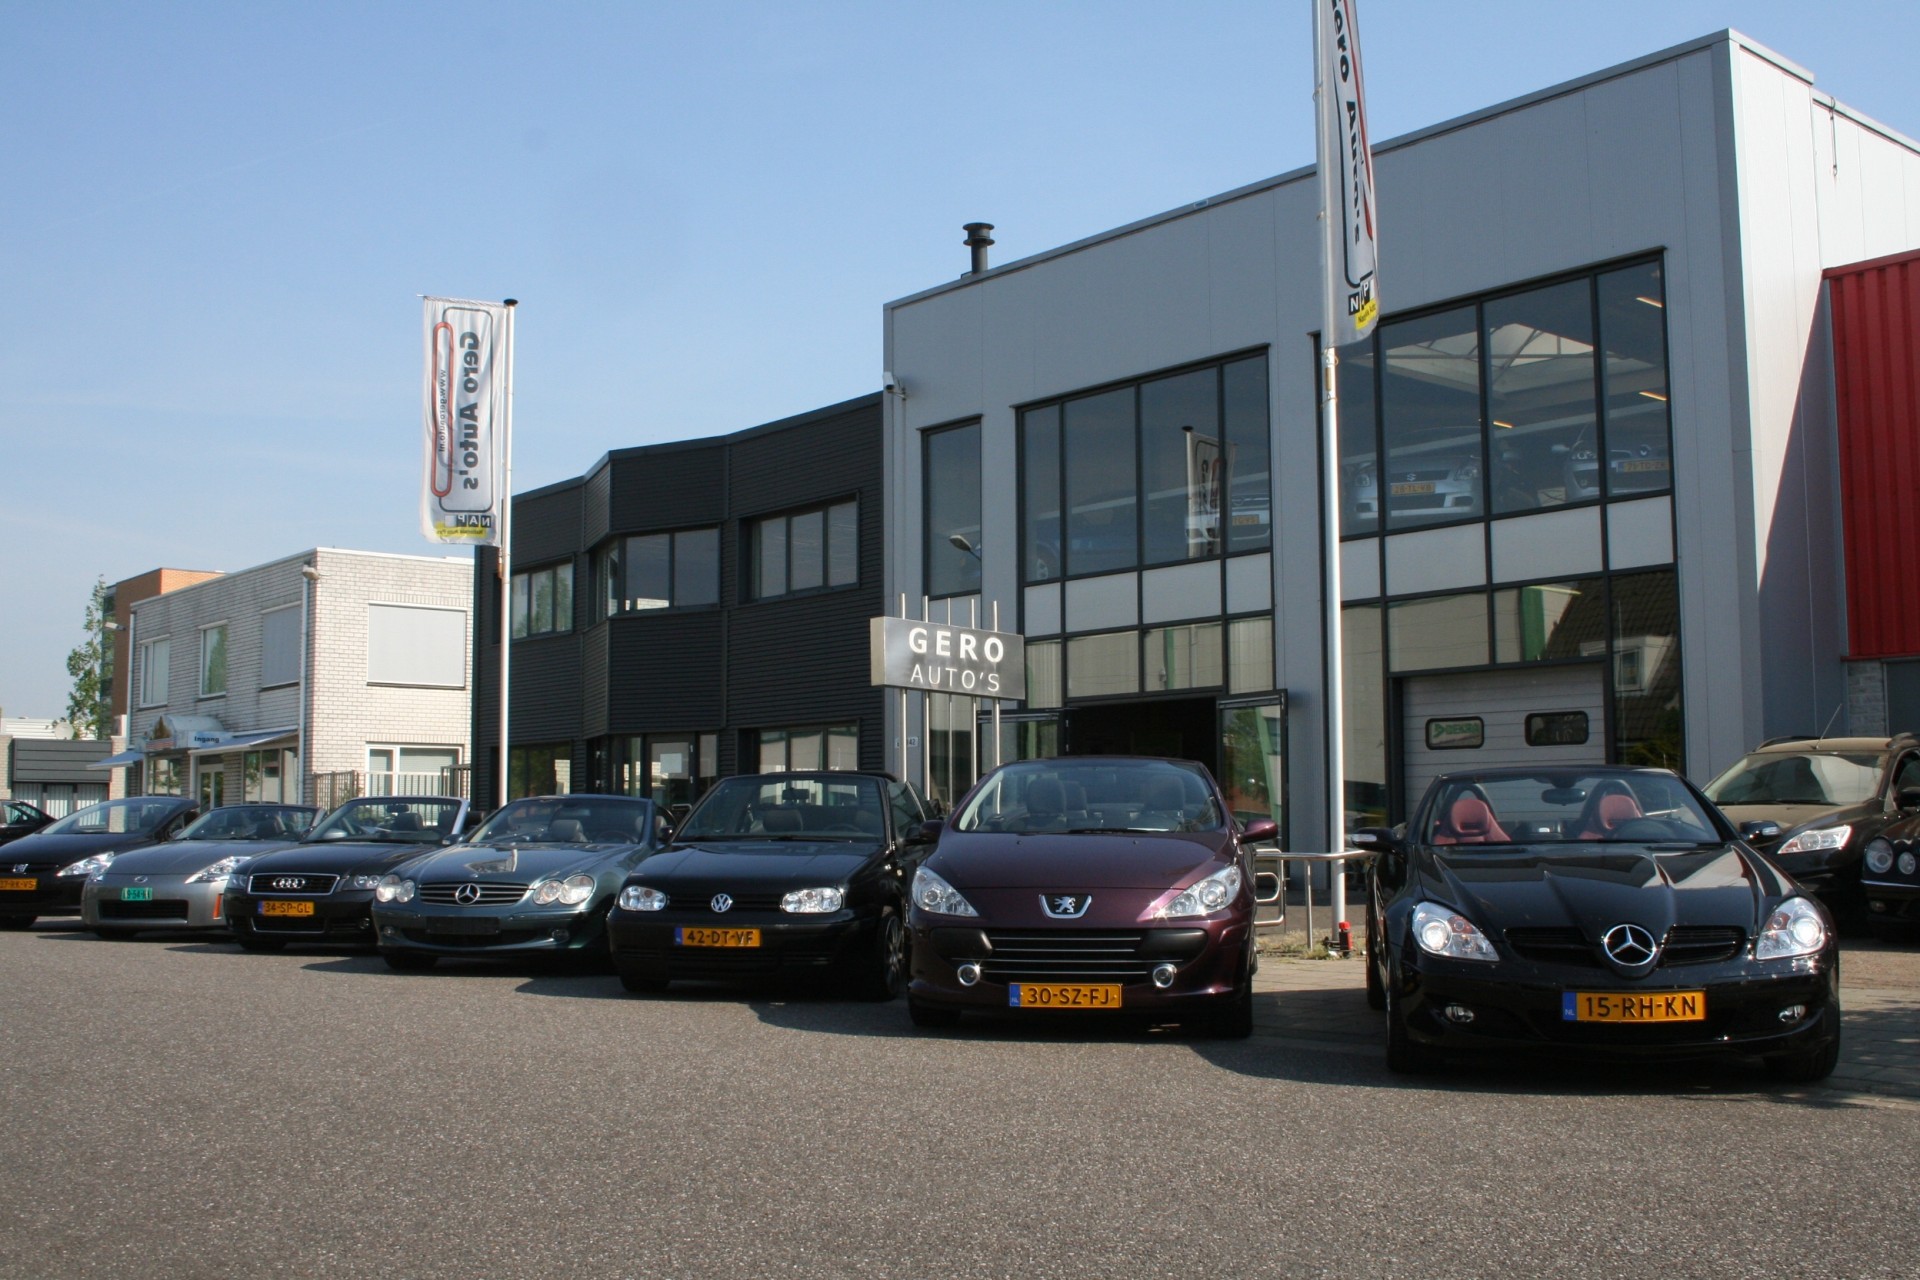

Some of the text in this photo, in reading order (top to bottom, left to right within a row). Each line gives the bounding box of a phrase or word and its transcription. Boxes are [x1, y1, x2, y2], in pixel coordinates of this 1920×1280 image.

[1350, 281, 1369, 312] NP
[908, 627, 1004, 663] GERO
[910, 664, 1000, 692] AUTO'S
[194, 735, 220, 744] Ingang
[265, 902, 310, 913] 34-SP-GL
[687, 930, 754, 944] 42-DT-VF
[1028, 988, 1109, 1005] 30-SZ-FJ
[1564, 995, 1696, 1018] NL 15-RH-KN
